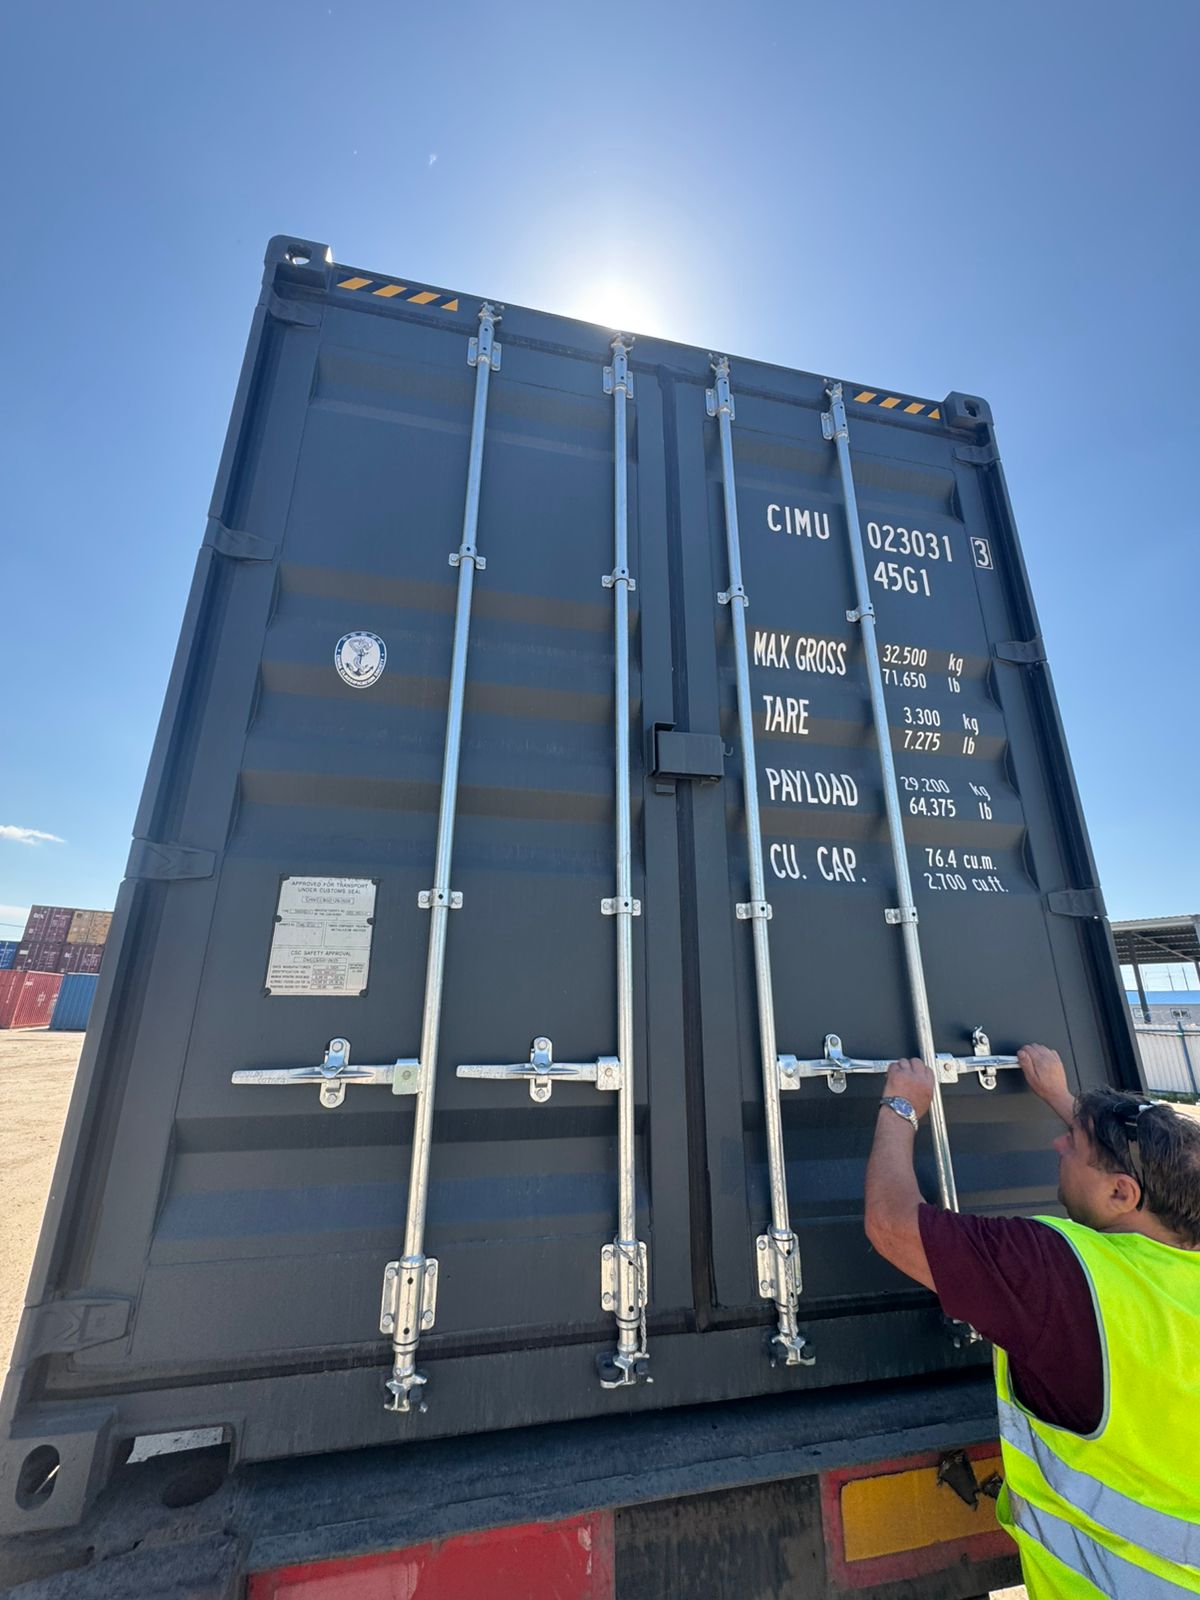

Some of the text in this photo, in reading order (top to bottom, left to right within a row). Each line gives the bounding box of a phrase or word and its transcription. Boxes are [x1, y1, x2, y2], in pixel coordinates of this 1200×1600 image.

[767, 504, 990, 567] CIMU 023031 3
[873, 560, 931, 597] 45G1
[753, 631, 964, 677] MAX GROSS 32.500 kg
[881, 668, 961, 694] 71.650 lb
[763, 695, 980, 736] TARE 3.300 kg
[903, 729, 977, 755] 7.275 lb
[765, 768, 992, 807] PAYLOAD 29.200 kg
[909, 796, 993, 821] 64.375 lb
[769, 843, 808, 880] CU.
[816, 846, 867, 883] CAP.
[924, 848, 958, 869] 76.4
[923, 872, 968, 891] 2.700
